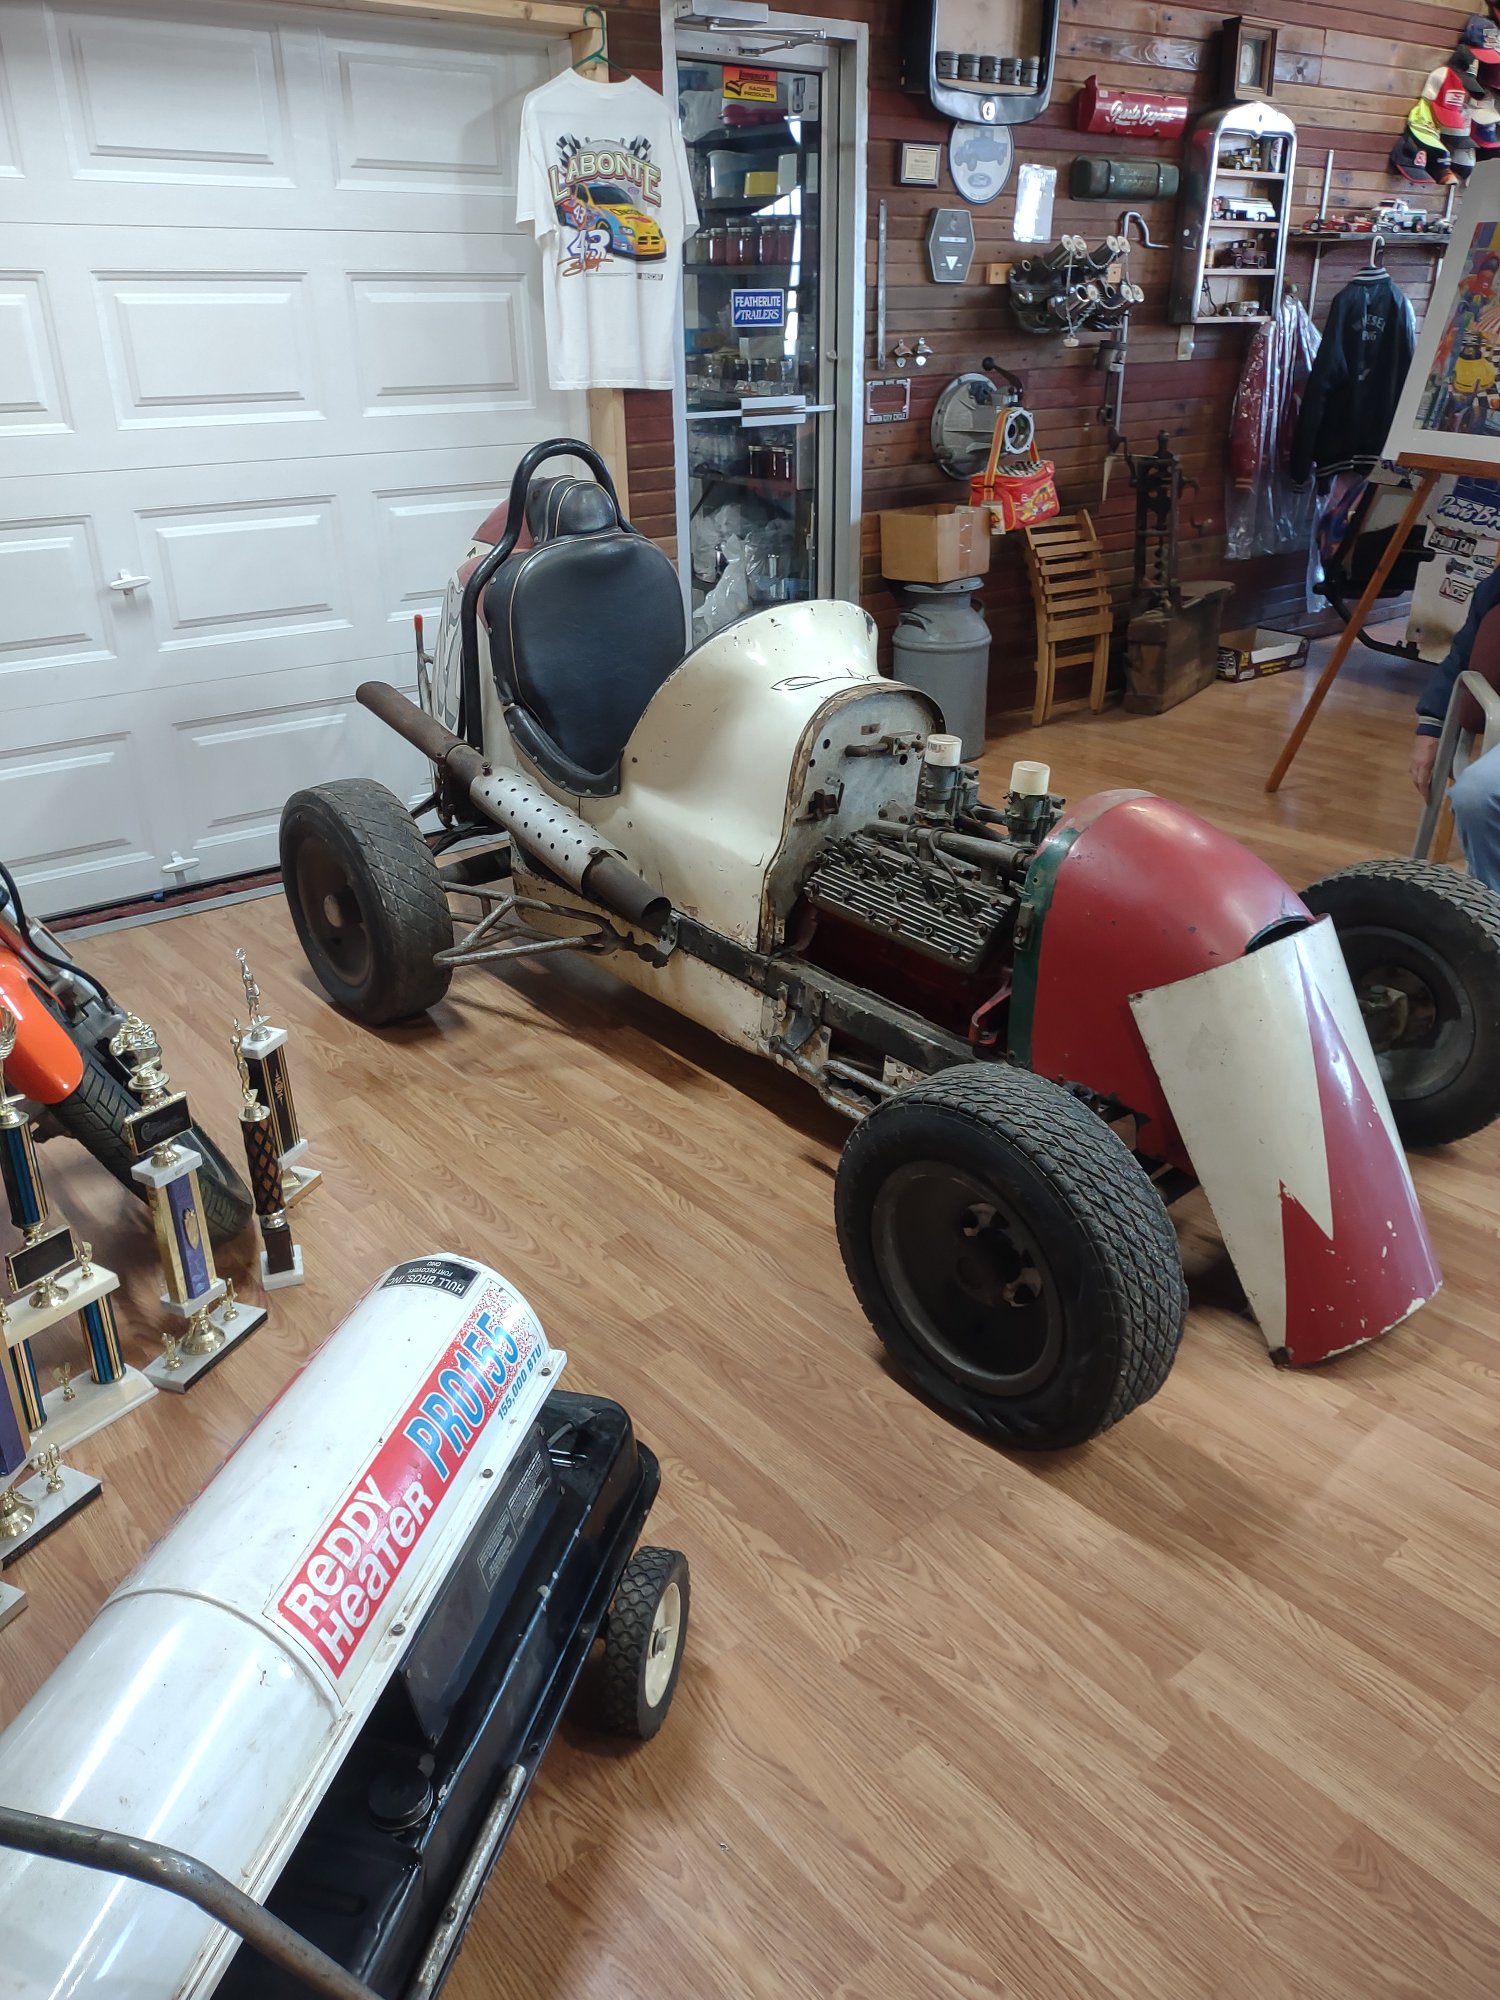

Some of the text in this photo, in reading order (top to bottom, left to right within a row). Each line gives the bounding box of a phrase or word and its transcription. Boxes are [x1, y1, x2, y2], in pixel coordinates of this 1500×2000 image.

[743, 91, 775, 99] PRODUCTS
[548, 150, 662, 208] LABONTE
[566, 229, 611, 262] 43
[735, 295, 782, 307] FEATHERLITE
[740, 309, 780, 321] TRAILERS
[1430, 531, 1477, 555] SPRINT CAR
[1440, 577, 1469, 602] NOS
[435, 1269, 454, 1277] FORT
[437, 1277, 466, 1294] HULL
[497, 1367, 529, 1421] 155,000
[527, 1344, 543, 1374] BTU
[403, 1311, 519, 1483] PRO155
